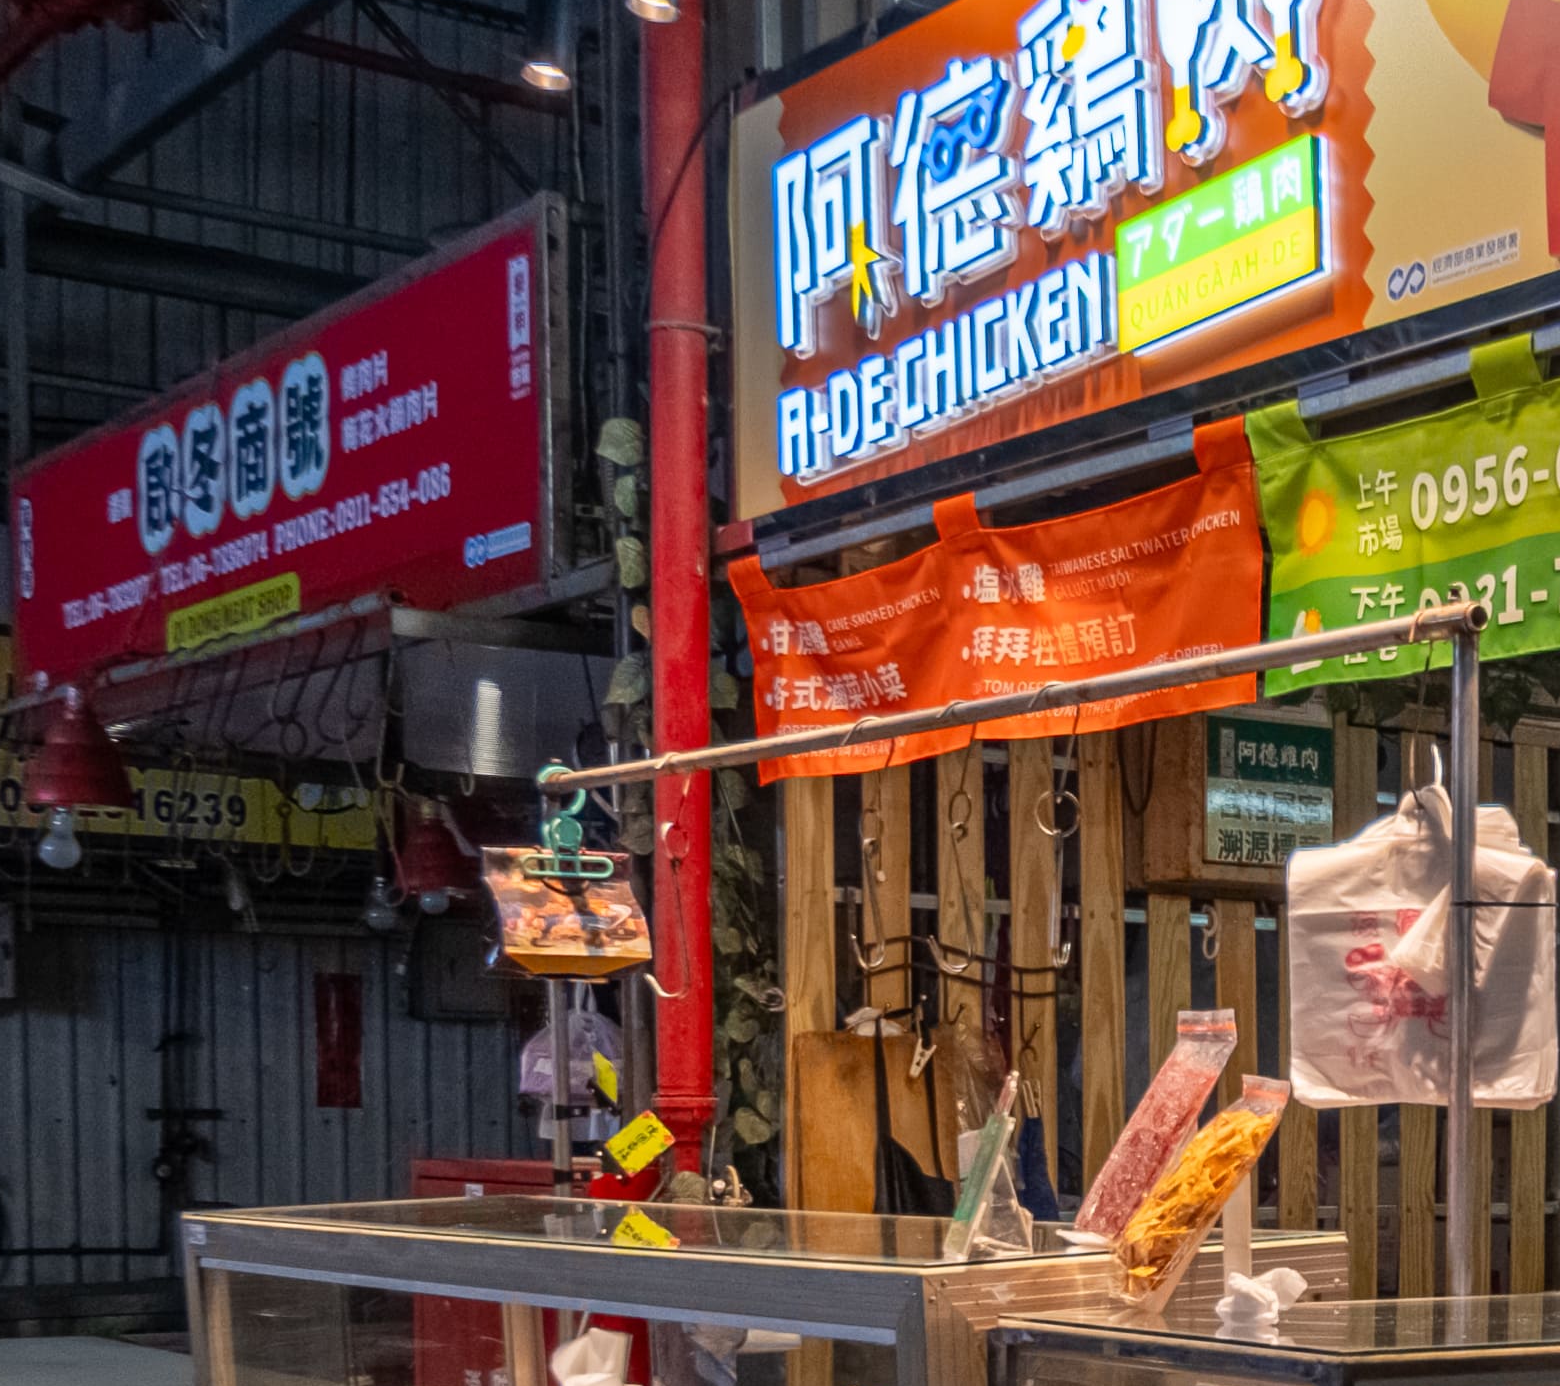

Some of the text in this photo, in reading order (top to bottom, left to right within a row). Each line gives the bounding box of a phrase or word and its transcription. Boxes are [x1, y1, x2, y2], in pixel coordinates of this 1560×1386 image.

[1131, 231, 1303, 331] QUÁN GÀ AH-DE
[778, 253, 1110, 476] A-DE CHICKEN
[1356, 468, 1399, 511] 上午
[1190, 509, 1241, 540] CHICKEN
[1357, 515, 1404, 557] 市場
[1349, 582, 1406, 621] 下午
